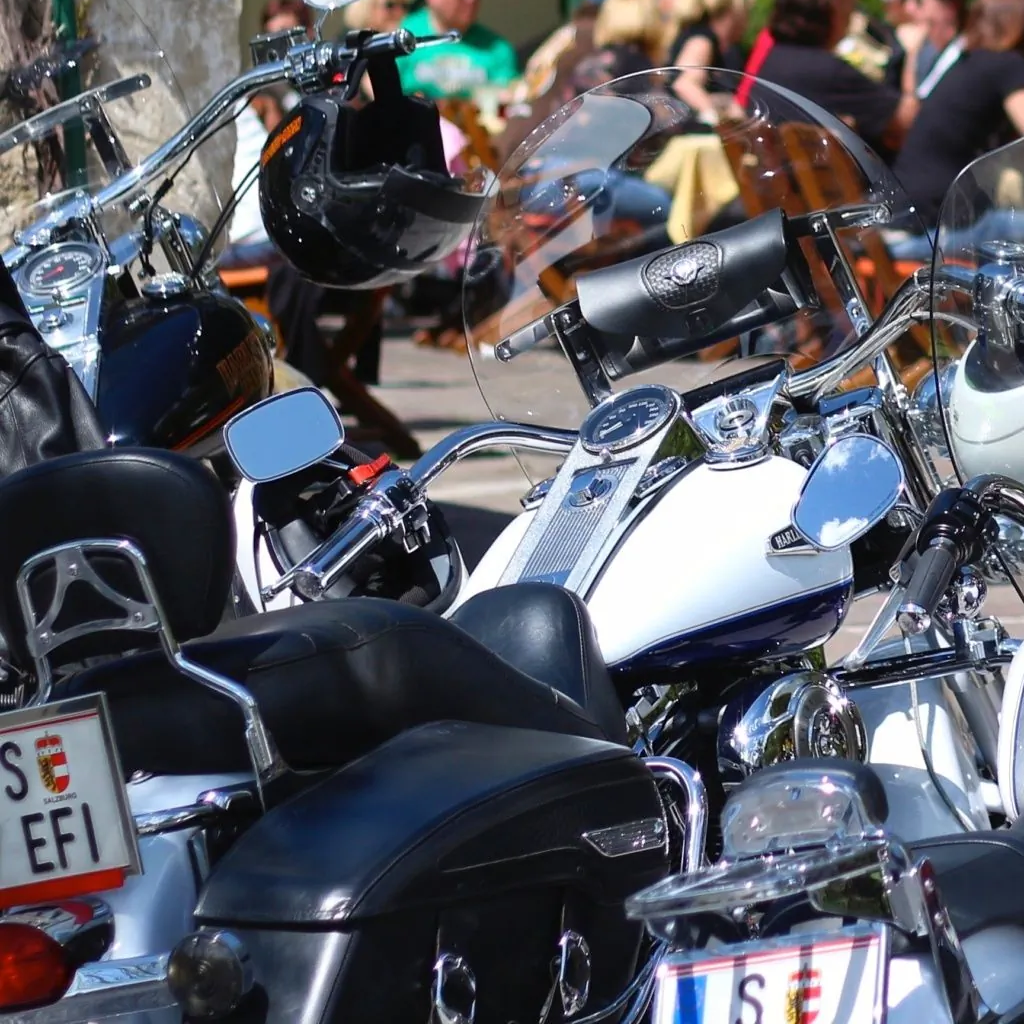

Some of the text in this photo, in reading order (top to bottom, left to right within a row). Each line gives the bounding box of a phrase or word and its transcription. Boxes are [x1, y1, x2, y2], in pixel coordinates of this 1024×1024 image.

[0, 741, 29, 801] S
[21, 802, 99, 874] EFI
[736, 974, 765, 1024] S
